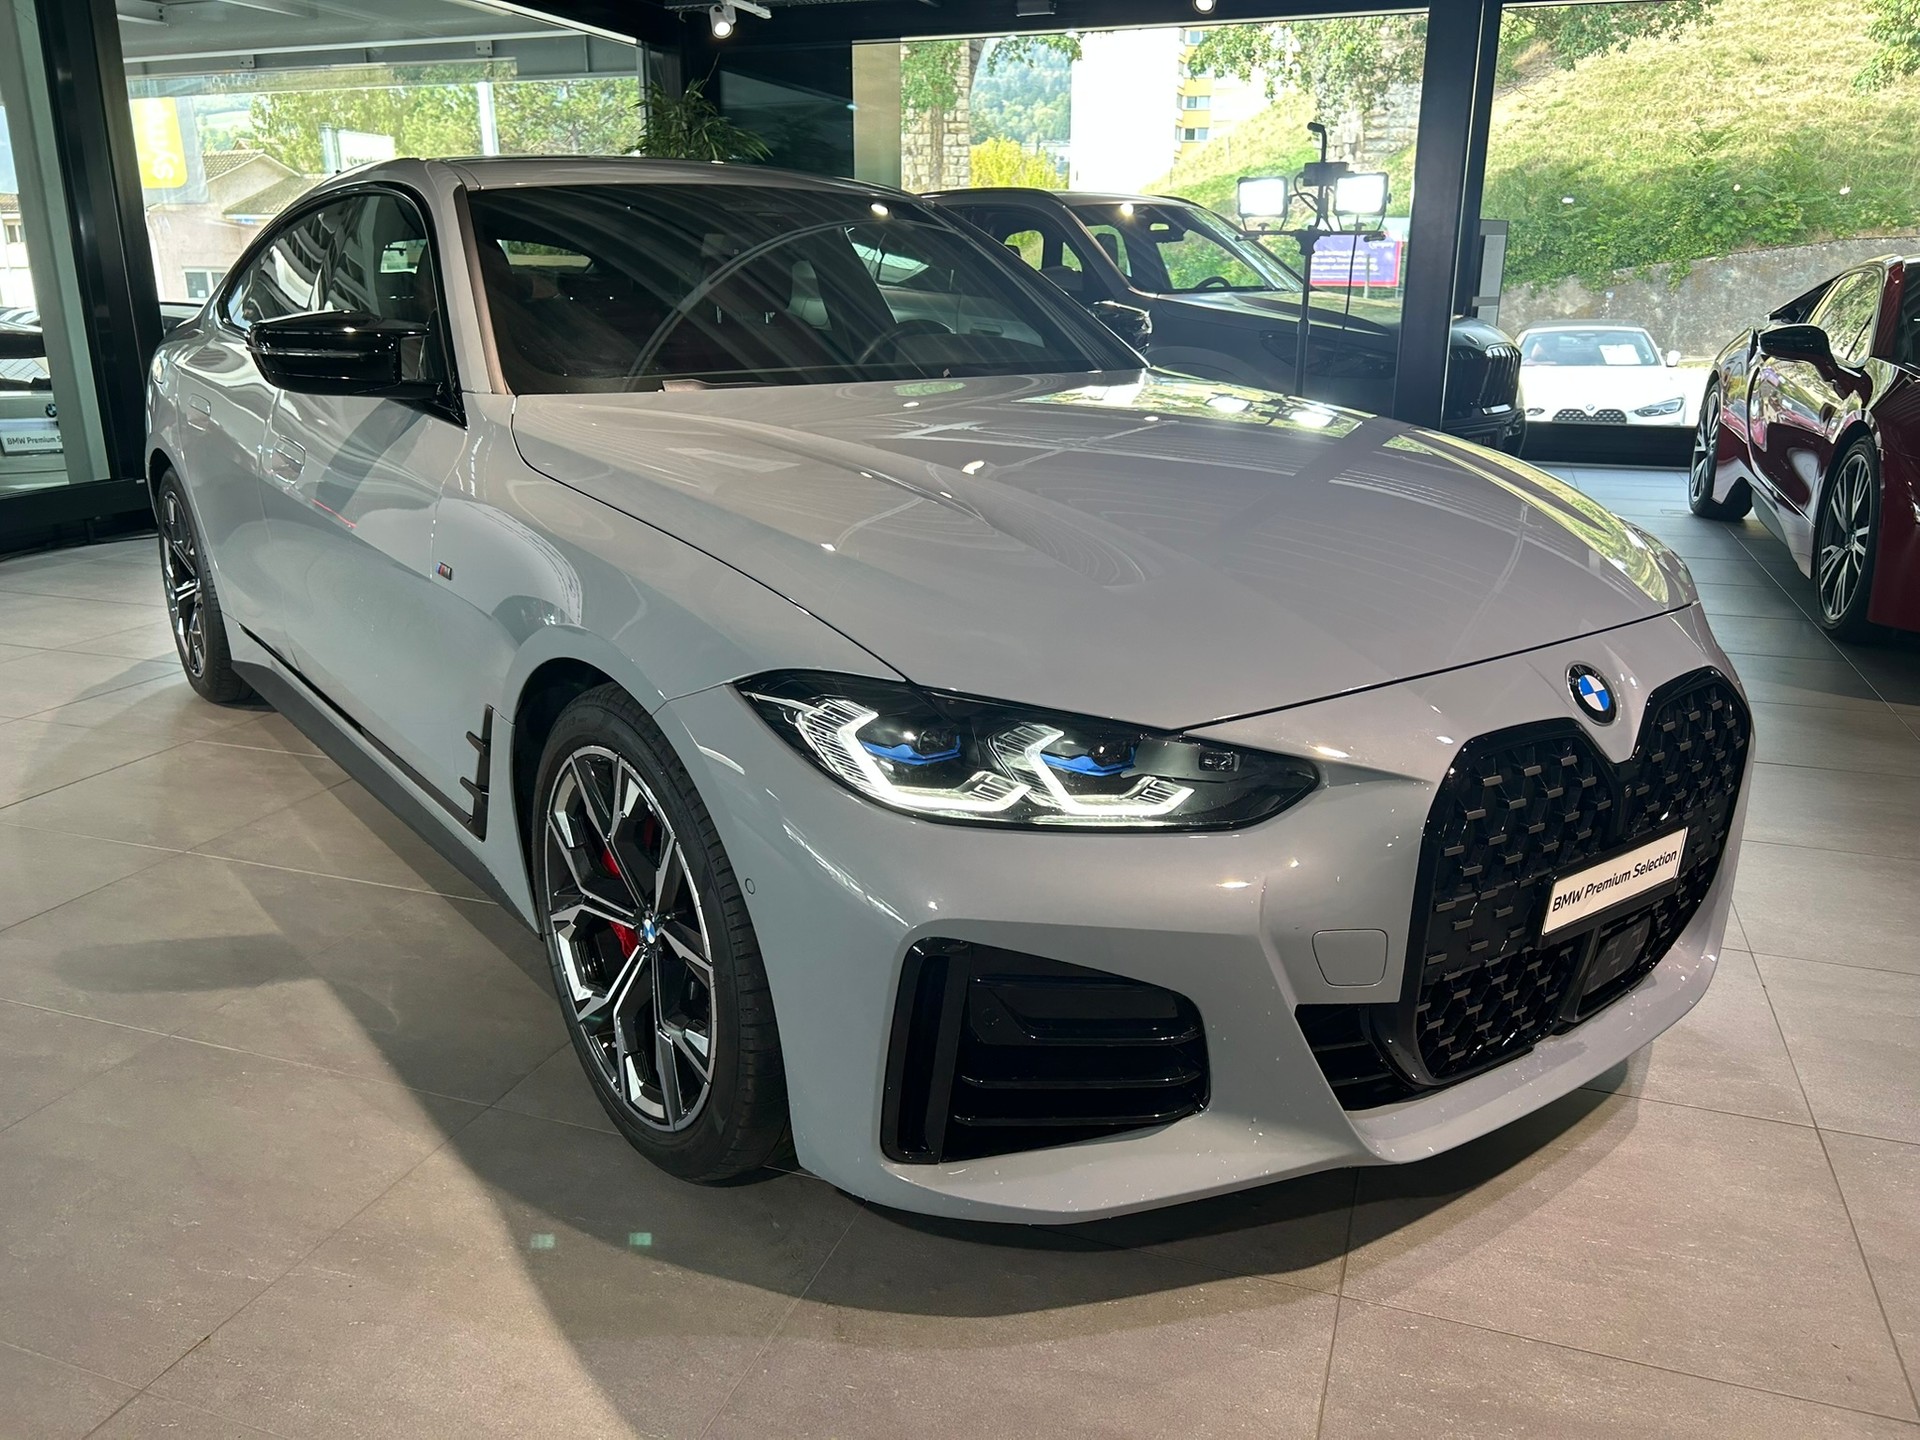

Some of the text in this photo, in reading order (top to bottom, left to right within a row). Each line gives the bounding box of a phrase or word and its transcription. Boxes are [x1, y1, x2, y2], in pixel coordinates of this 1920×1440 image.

[6, 437, 26, 445] BMW
[27, 436, 57, 444] Premium
[1552, 850, 1677, 912] BMW Premium Selection
